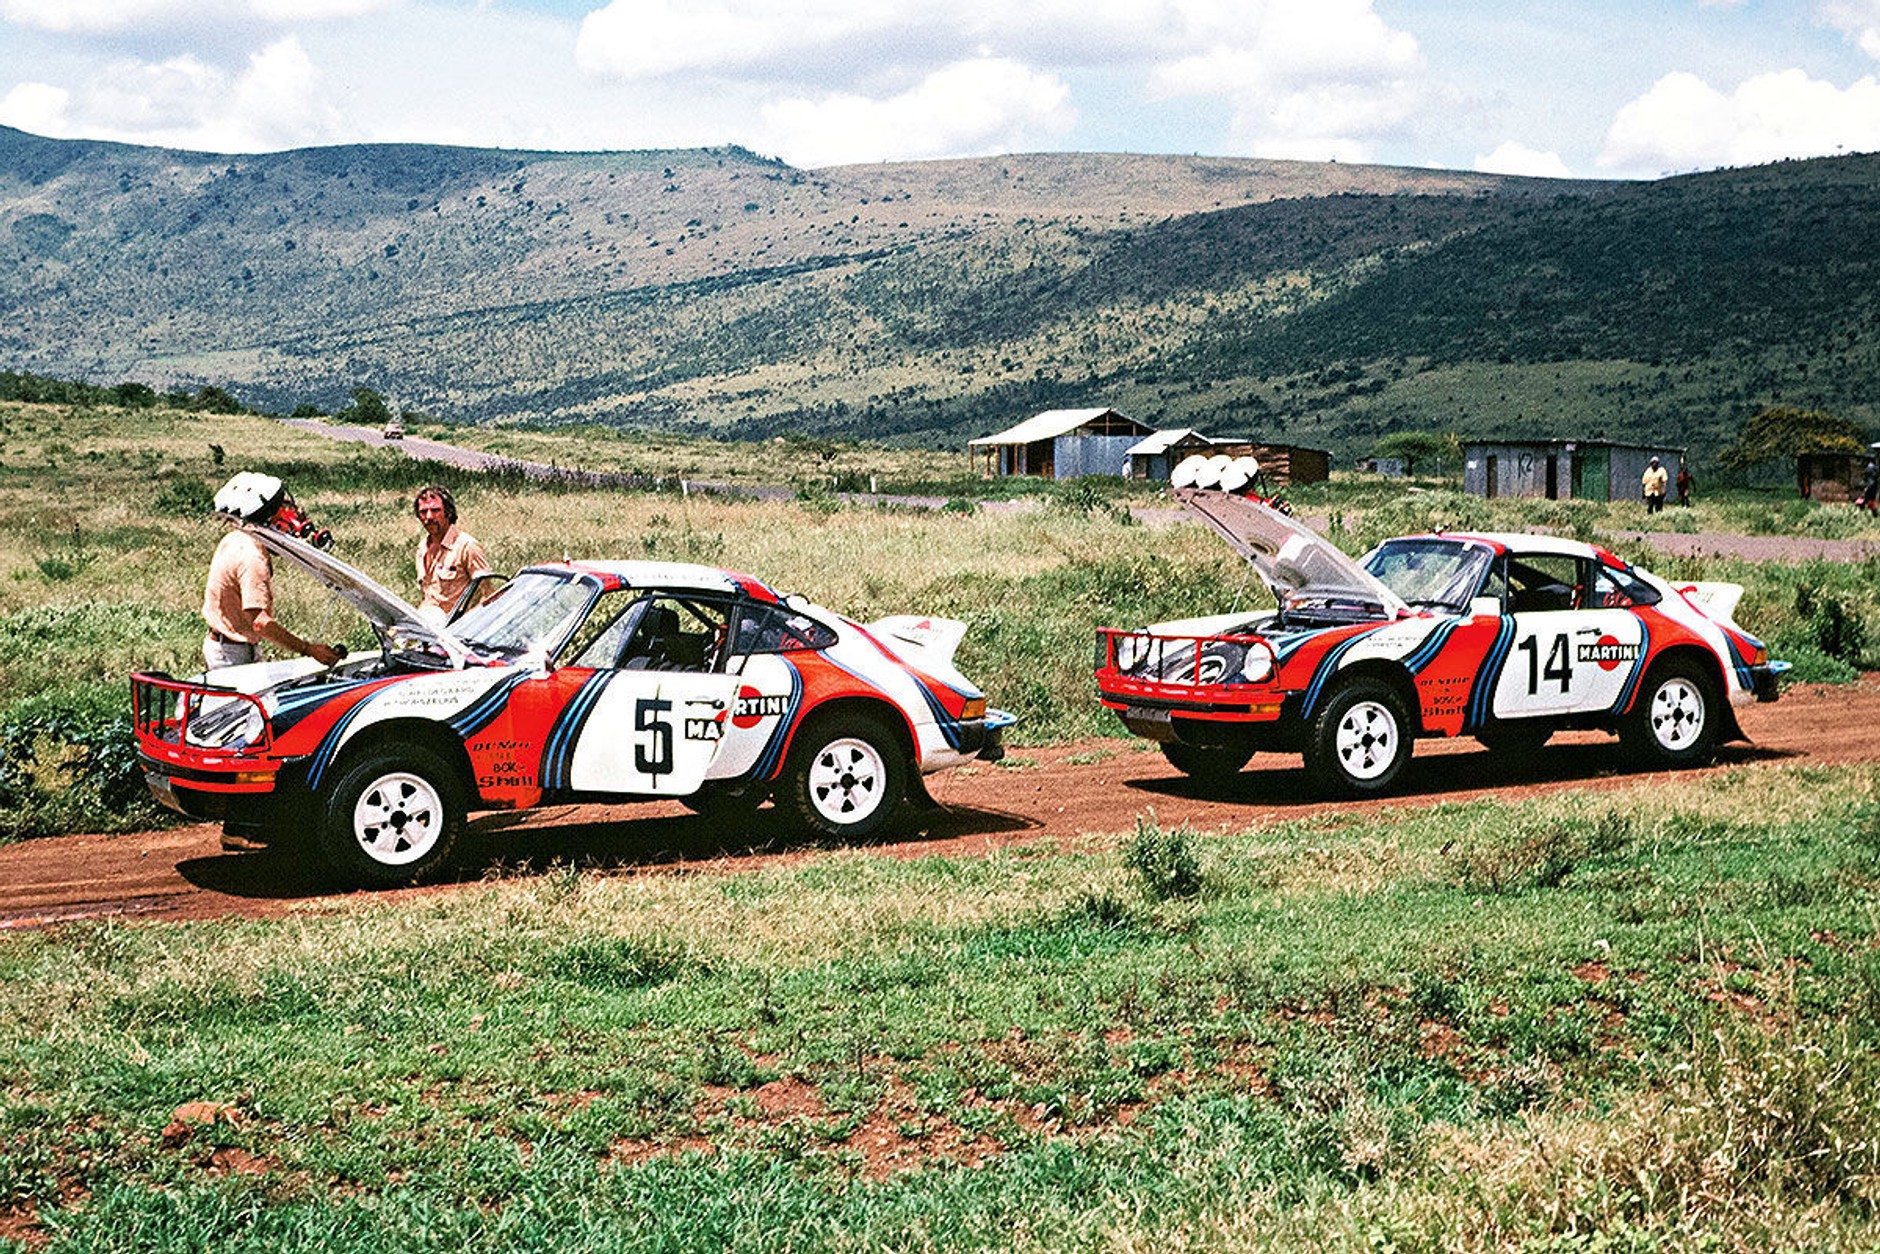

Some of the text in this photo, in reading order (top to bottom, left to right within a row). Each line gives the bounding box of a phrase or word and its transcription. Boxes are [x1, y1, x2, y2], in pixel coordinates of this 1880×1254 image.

[1518, 633, 1573, 695] 14
[1579, 645, 1640, 660] MARTINI
[634, 698, 673, 775] 5
